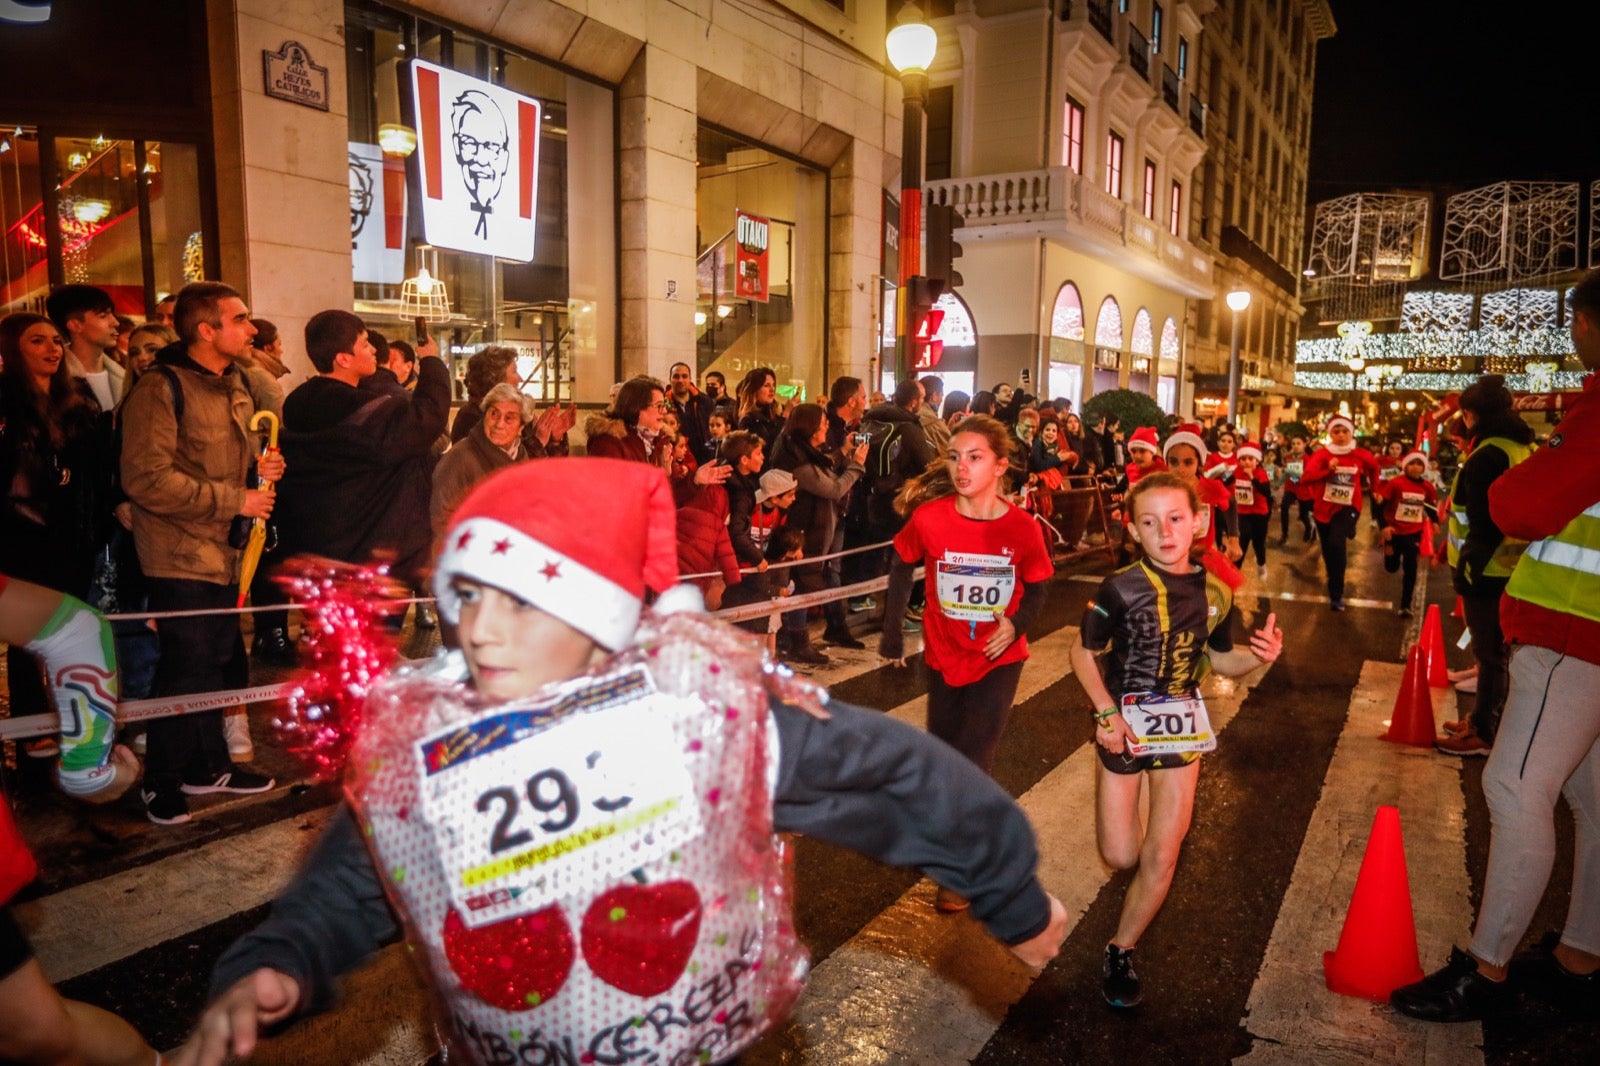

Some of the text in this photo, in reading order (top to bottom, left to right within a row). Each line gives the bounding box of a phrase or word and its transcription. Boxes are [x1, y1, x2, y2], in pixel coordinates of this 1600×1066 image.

[283, 72, 311, 87] REYES
[1331, 487, 1350, 498] 290
[953, 584, 1000, 605] 180
[1144, 712, 1196, 735] 207
